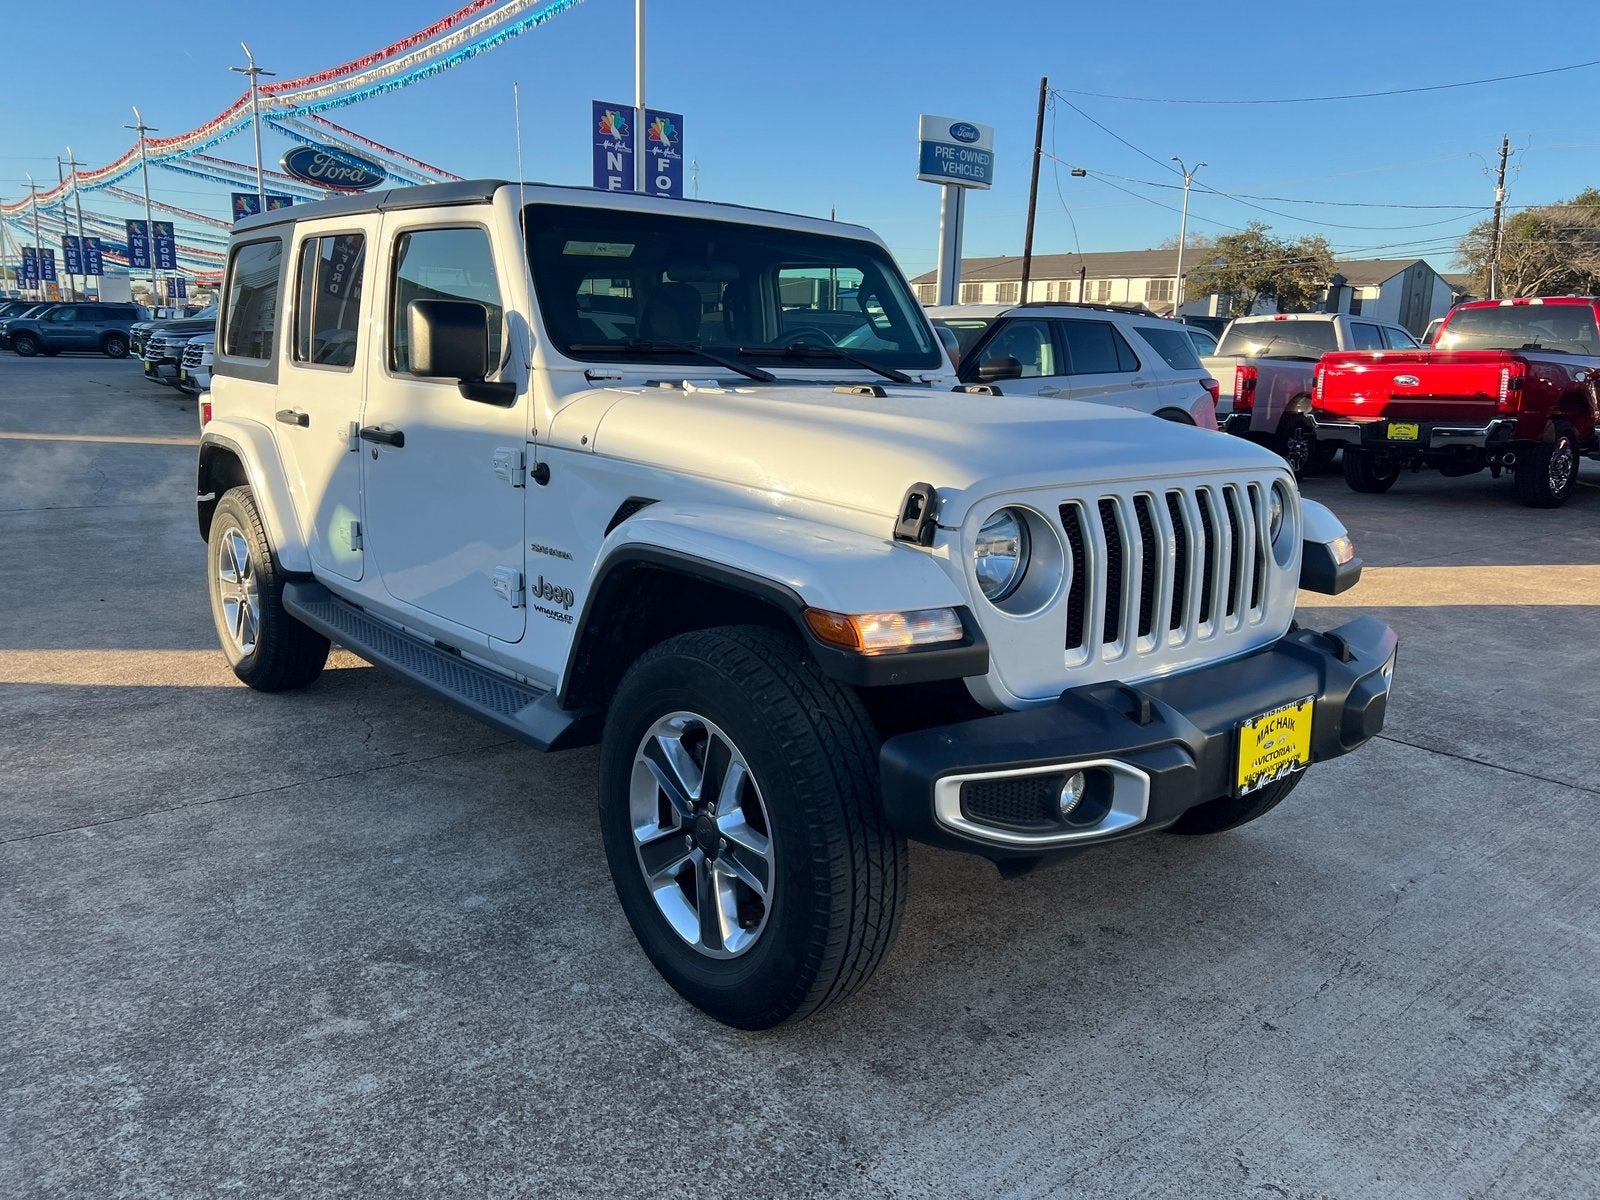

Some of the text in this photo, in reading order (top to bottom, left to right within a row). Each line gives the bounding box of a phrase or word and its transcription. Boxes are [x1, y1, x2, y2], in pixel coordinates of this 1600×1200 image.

[308, 152, 367, 183] Ford
[935, 146, 990, 166] PRE-OWNED
[942, 161, 985, 177] VEHICLES
[90, 252, 99, 274] FORD
[133, 239, 146, 267] NEW
[160, 241, 170, 268] FORD
[532, 575, 574, 611] Jeep
[533, 603, 574, 621] WRANGLER
[1256, 720, 1275, 747] MAC
[1276, 717, 1296, 732] HAIK
[1258, 745, 1292, 766] VICTORIA
